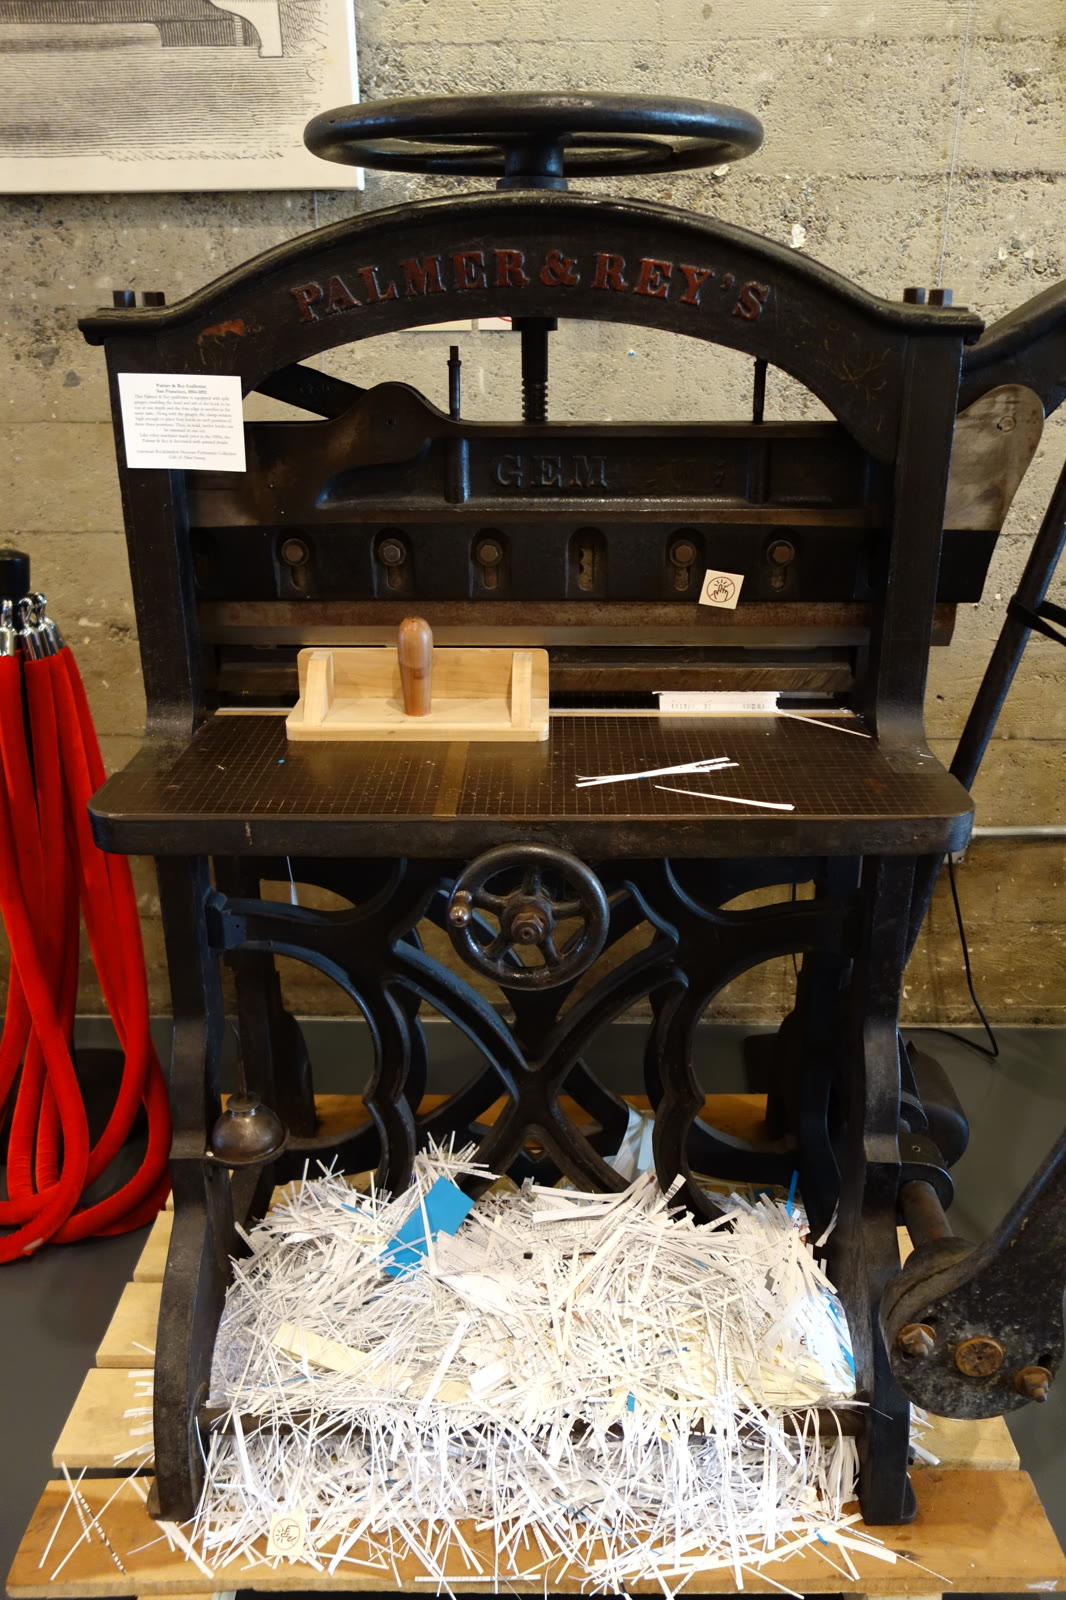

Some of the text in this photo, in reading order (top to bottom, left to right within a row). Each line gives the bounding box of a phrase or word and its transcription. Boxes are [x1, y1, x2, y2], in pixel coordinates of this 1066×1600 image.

[290, 249, 770, 322] PALMER & REY'S
[495, 454, 608, 488] GEM
